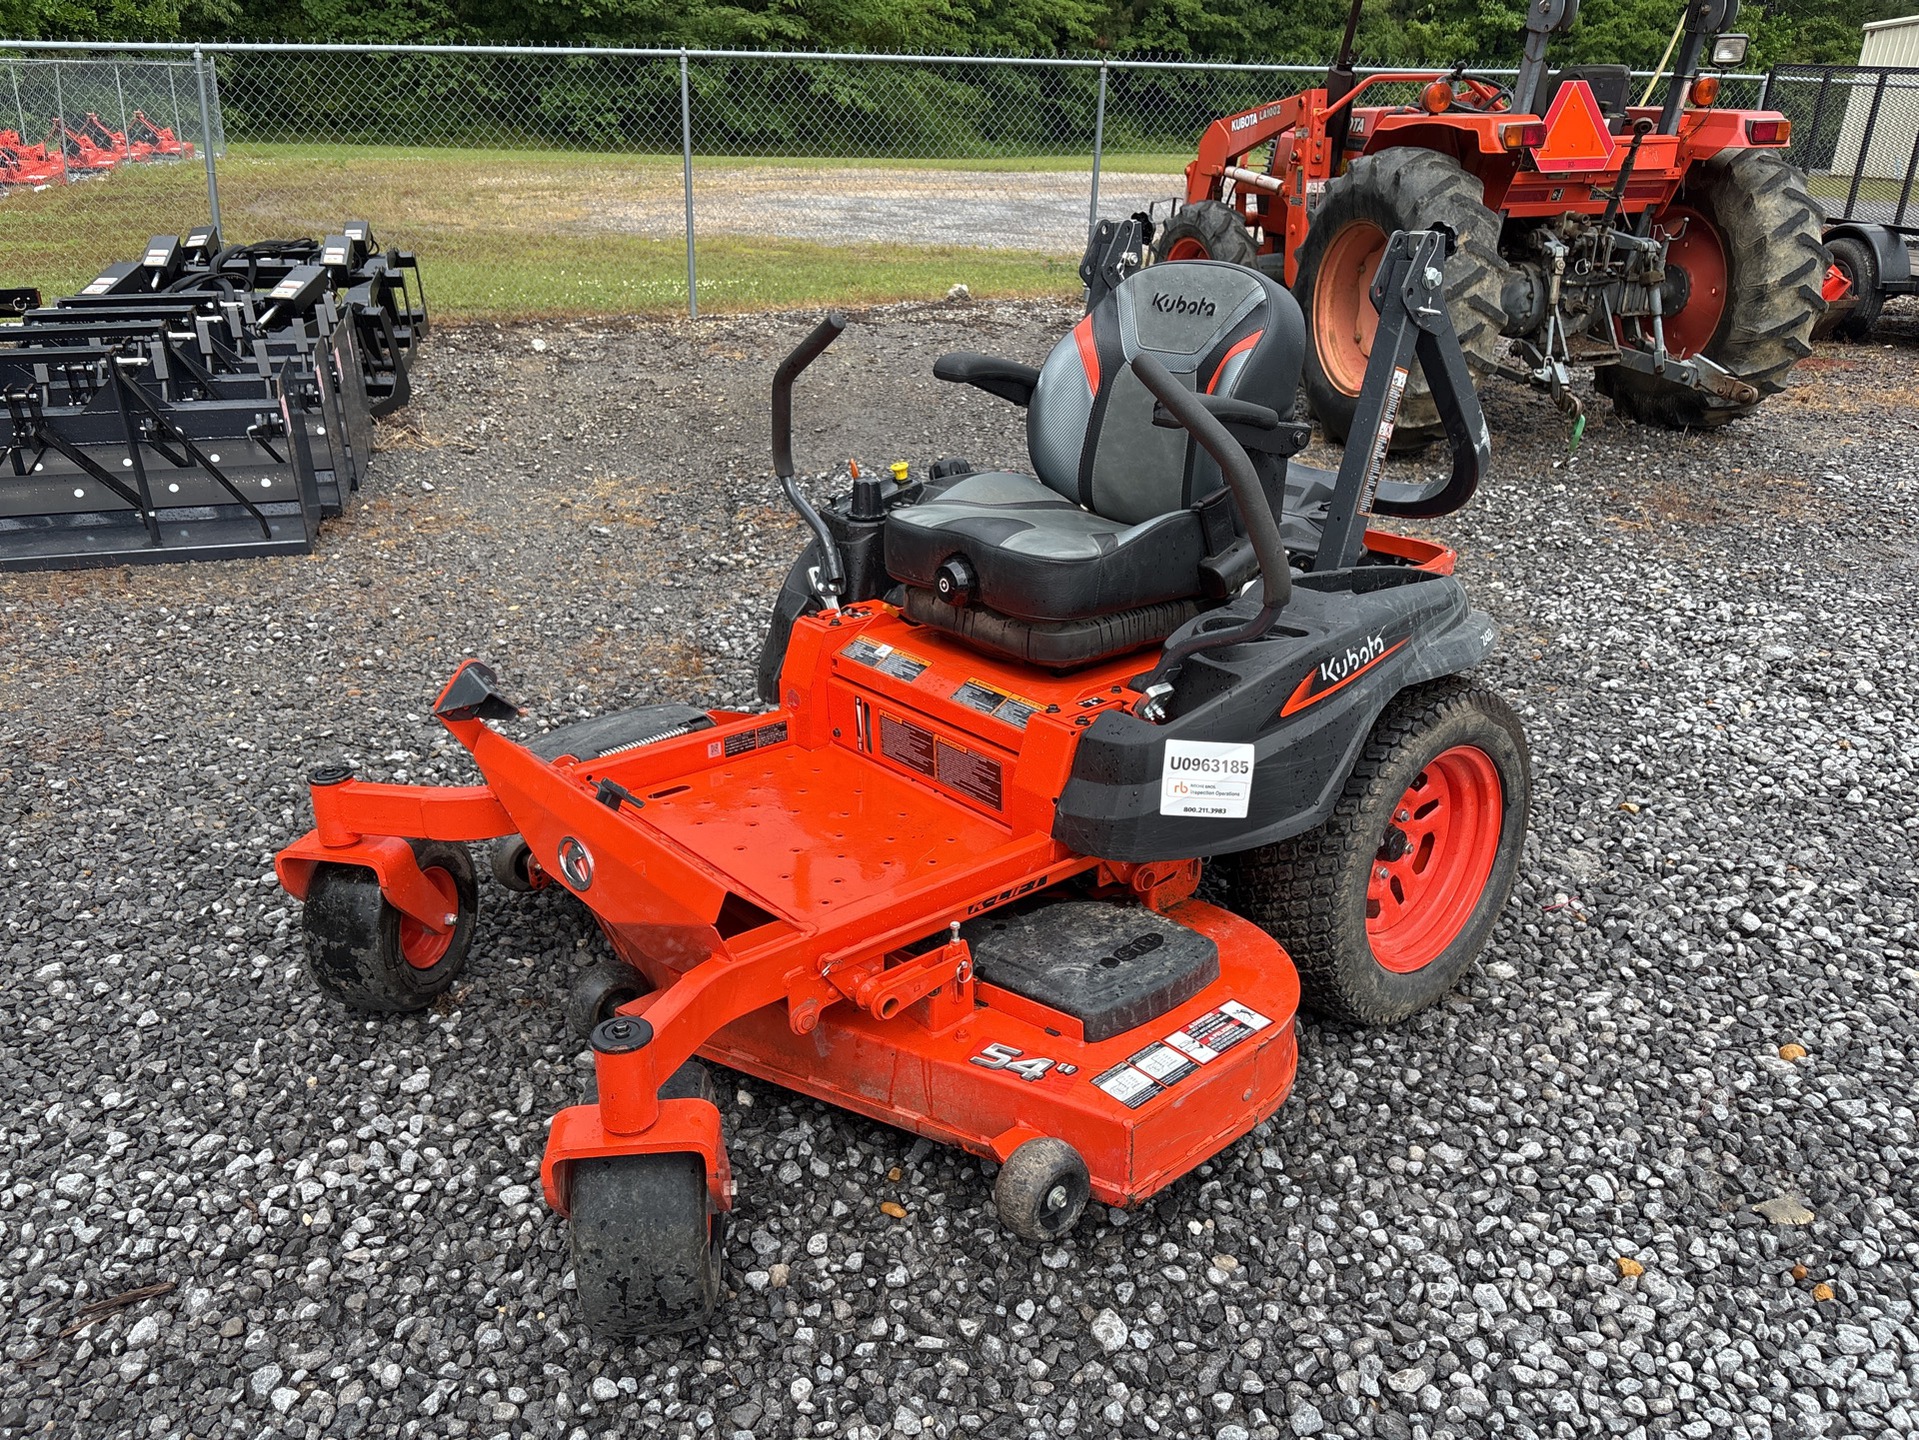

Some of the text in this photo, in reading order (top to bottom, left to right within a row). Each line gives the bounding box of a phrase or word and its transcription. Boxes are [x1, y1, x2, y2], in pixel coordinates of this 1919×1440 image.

[1231, 113, 1258, 132] KUBOTA
[1152, 292, 1217, 317] Kubota
[1321, 635, 1385, 682] Kubota
[1170, 756, 1249, 774] U0963185
[1174, 781, 1188, 794] rb
[1183, 806, 1227, 815] 800.211.3983
